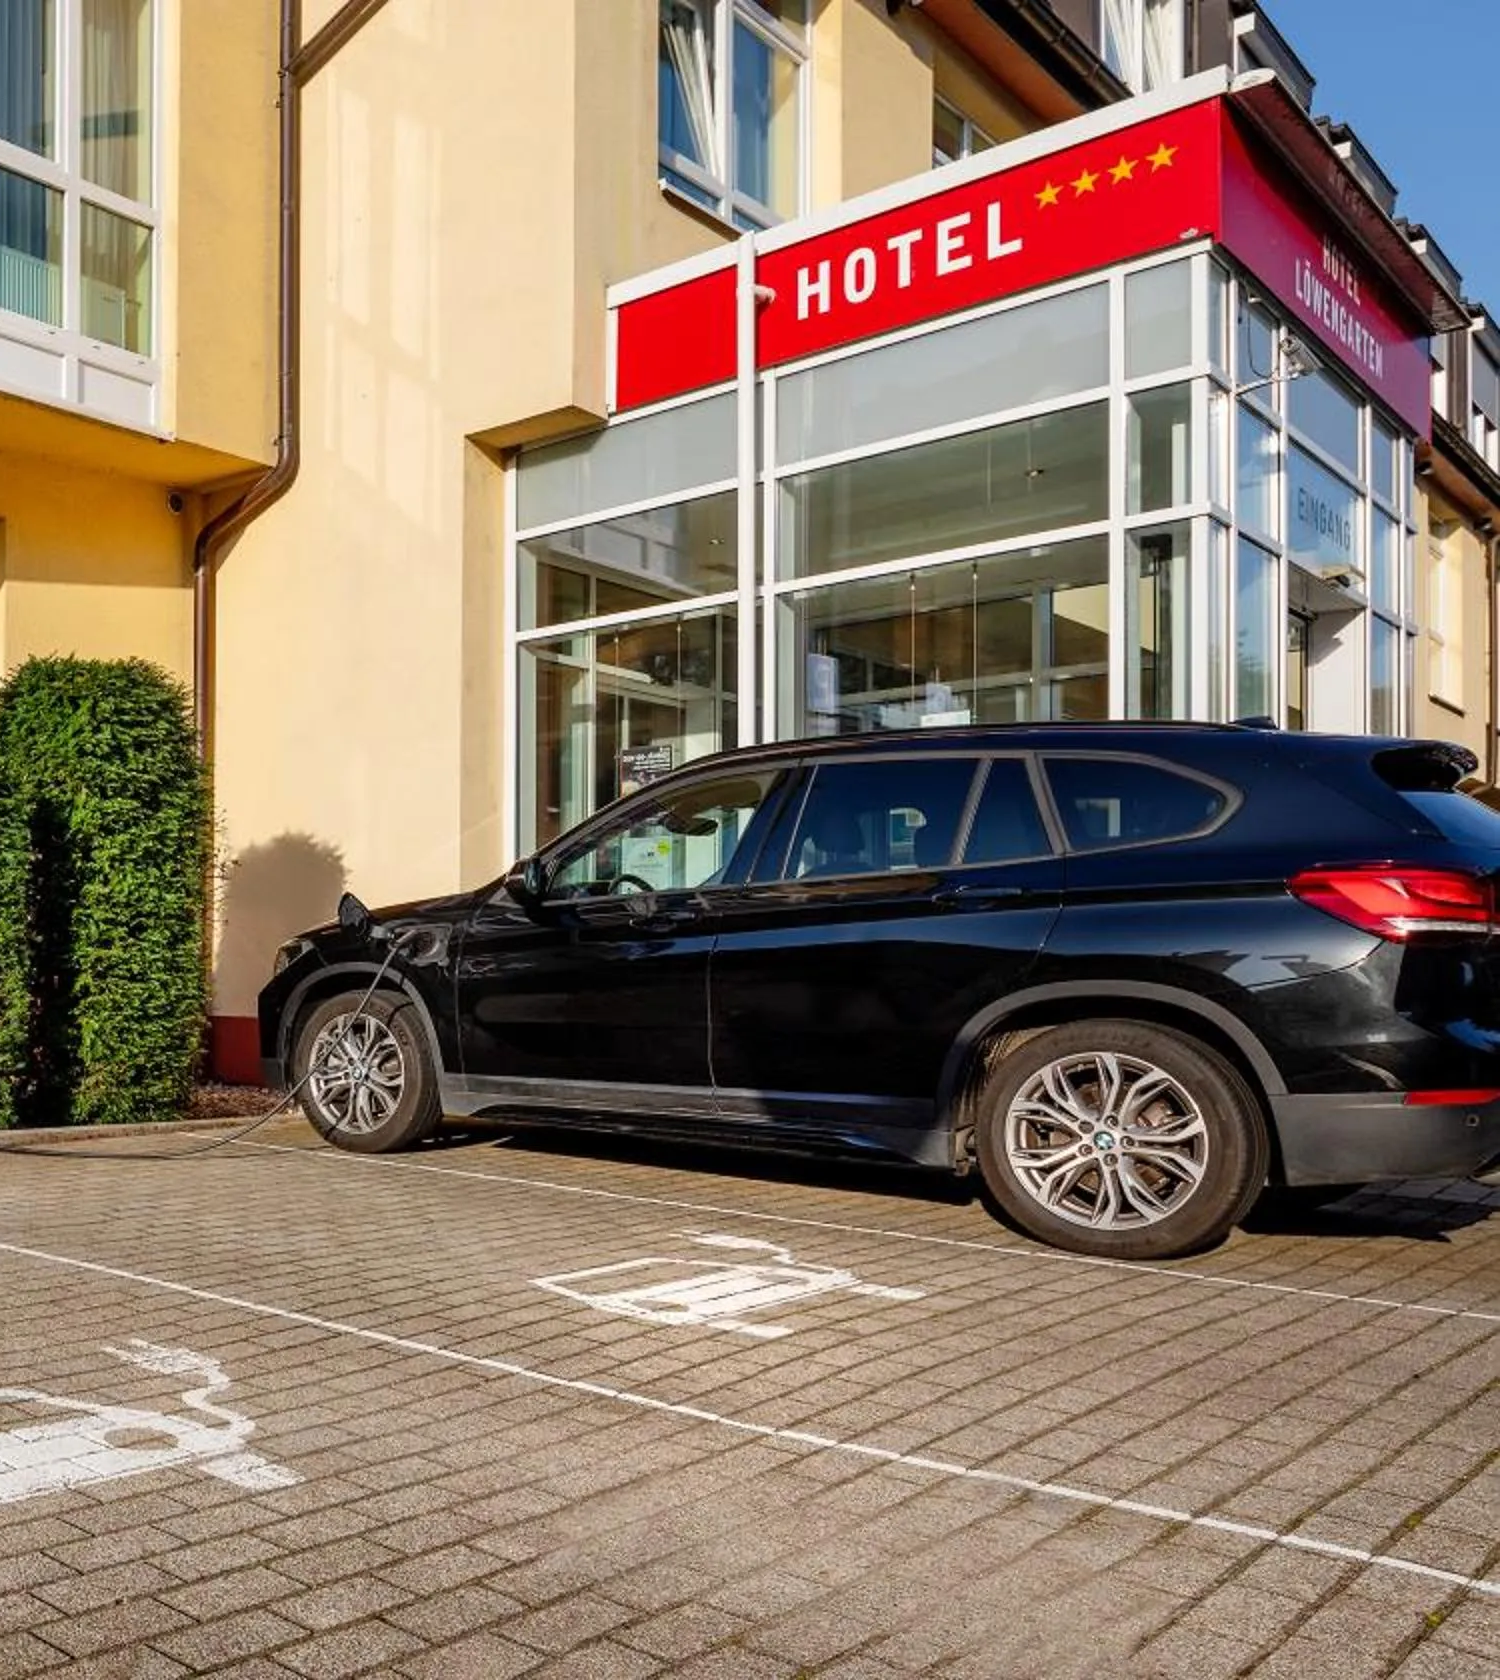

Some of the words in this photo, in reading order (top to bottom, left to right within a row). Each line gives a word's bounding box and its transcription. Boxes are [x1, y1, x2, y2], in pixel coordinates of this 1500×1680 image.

[797, 201, 1022, 319] HOTEL
[1322, 235, 1360, 306] HOTEL
[1295, 257, 1383, 379] LÖWENGARTEN
[1298, 487, 1351, 551] EINGANG
